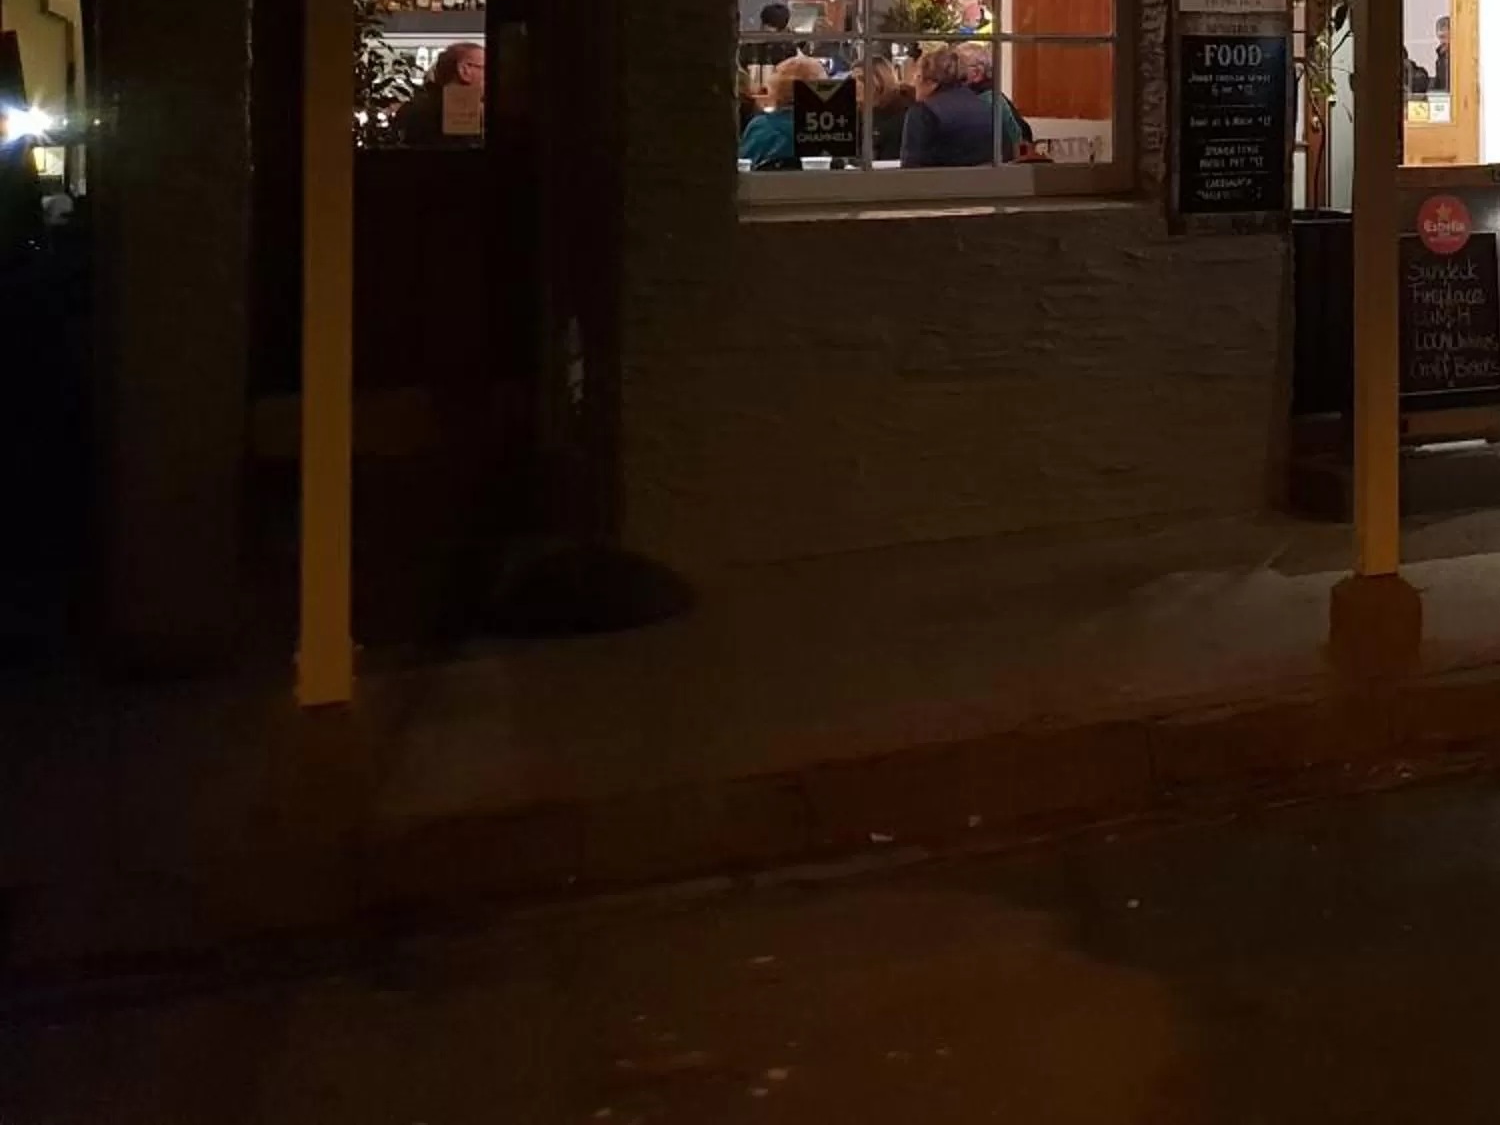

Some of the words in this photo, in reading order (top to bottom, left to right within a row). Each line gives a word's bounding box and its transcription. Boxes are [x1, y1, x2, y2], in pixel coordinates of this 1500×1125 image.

[1203, 43, 1263, 67] FOOD
[803, 110, 849, 132] 50+
[796, 131, 854, 143] CHANNELS
